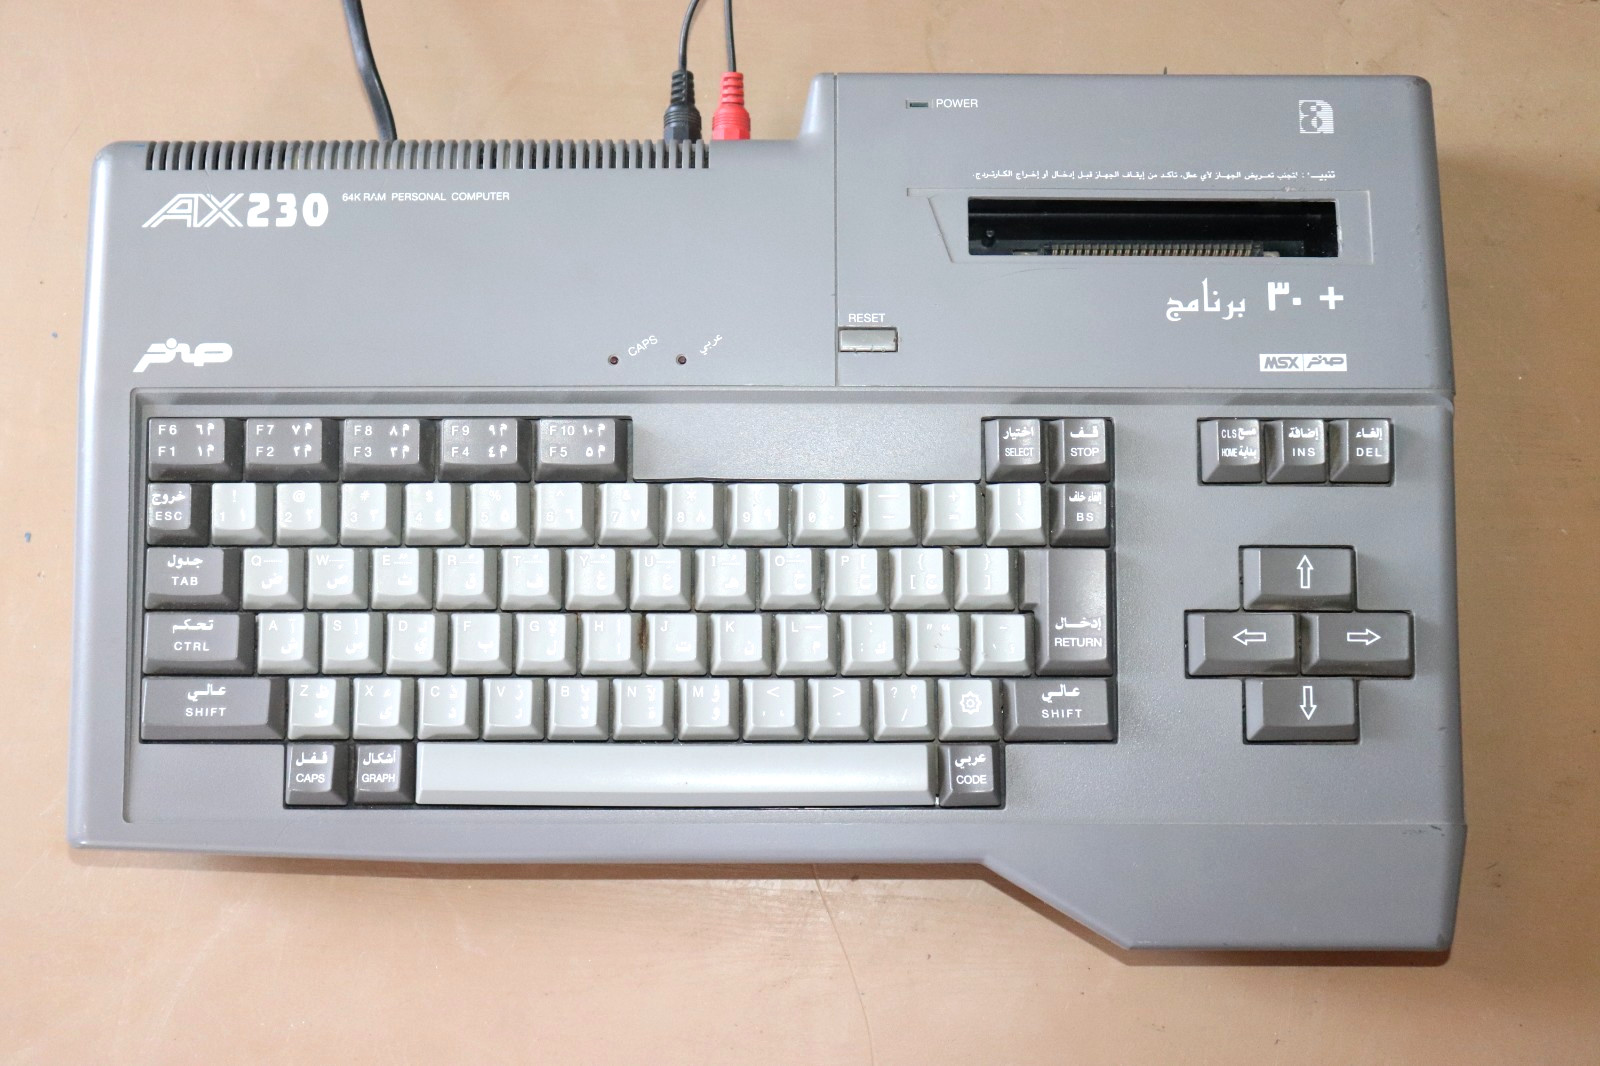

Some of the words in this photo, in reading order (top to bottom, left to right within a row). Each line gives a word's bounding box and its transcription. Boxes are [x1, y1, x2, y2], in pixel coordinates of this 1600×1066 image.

[936, 98, 979, 108] POWER
[1015, 171, 1040, 180] إخراج
[1041, 170, 1049, 180] أو
[1051, 170, 1075, 180] إدخال
[1077, 171, 1093, 179] قبل
[1094, 170, 1119, 180] الجهاز
[1122, 171, 1145, 180] إيقاف
[1147, 172, 1158, 180] من
[1215, 170, 1241, 180] الجهاز
[1244, 172, 1275, 180] تعريض
[1307, 171, 1336, 181] تنبي
[342, 192, 362, 202] 64K
[363, 192, 387, 202] RAM
[391, 192, 447, 201] PERSONAL
[451, 191, 510, 201] COMPUTER
[142, 193, 329, 228] AX230
[1166, 278, 1246, 321] برنامج
[848, 313, 886, 323] RESET
[627, 335, 658, 357] CAPS
[699, 332, 723, 356] عربي
[1263, 357, 1299, 370] MSX
[158, 425, 177, 435] F6
[256, 425, 275, 436] F7
[354, 425, 373, 436] F8
[451, 425, 470, 436] F9
[549, 425, 575, 436] F10
[1003, 426, 1034, 441] اختيار
[1070, 426, 1099, 439] قف
[1222, 429, 1237, 439] CLS
[1238, 427, 1257, 441] مسح
[1288, 427, 1319, 441] إضافة
[1355, 427, 1383, 441] إلغاء
[158, 446, 176, 457] F1
[256, 446, 275, 457] F2
[353, 446, 372, 457] F3
[451, 446, 470, 457] F4
[549, 446, 568, 457] F5
[1004, 447, 1034, 457] SELECT
[1070, 447, 1100, 457] STOP
[1222, 448, 1238, 457] HOME
[1238, 447, 1257, 459] بداية
[1292, 448, 1316, 457] INS
[1356, 448, 1382, 457] DEL
[151, 491, 186, 506] خروج
[155, 512, 183, 521] ESC
[219, 512, 225, 521] 1
[284, 512, 293, 523] 2
[350, 512, 358, 522] 3
[415, 512, 424, 521] 4
[481, 511, 489, 522] 5
[546, 511, 554, 521] 6
[611, 511, 619, 521] 7
[677, 511, 685, 522] 8
[742, 511, 751, 522] 9
[1076, 512, 1094, 522] BS
[167, 555, 204, 569] جدول
[251, 555, 262, 566] Q
[316, 555, 330, 566] W
[382, 555, 391, 566] E
[447, 555, 457, 566] R
[513, 555, 522, 566] T
[580, 555, 590, 567] Y
[644, 556, 654, 567] U
[711, 555, 716, 567] I
[774, 555, 785, 567] O
[841, 555, 850, 567] P
[171, 576, 199, 586] TAB
[172, 619, 214, 634] تحكم
[268, 620, 278, 631] A
[332, 620, 342, 631] S
[398, 621, 408, 631] D
[463, 621, 472, 631] F
[529, 621, 540, 632] G
[594, 621, 604, 631] H
[660, 621, 668, 632] J
[725, 621, 735, 632] K
[791, 621, 799, 632] L
[1055, 616, 1102, 631] إدخال
[173, 641, 210, 651] CTRL
[1054, 637, 1102, 647] RETURN
[187, 683, 227, 702] عالي
[300, 685, 309, 696] Z
[365, 685, 374, 696] X
[430, 685, 440, 697] C
[496, 685, 506, 697] V
[561, 686, 570, 697] B
[627, 686, 637, 697] N
[692, 686, 704, 697] M
[1041, 683, 1081, 704] عالي
[185, 707, 227, 717] SHIFT
[1041, 709, 1083, 719] SHIFT
[296, 751, 328, 767] قفل
[362, 751, 396, 766] أشكال
[954, 753, 987, 770] عربي
[296, 773, 325, 783] CAPS
[361, 773, 396, 783] GRAPH
[956, 774, 987, 784] CODE
